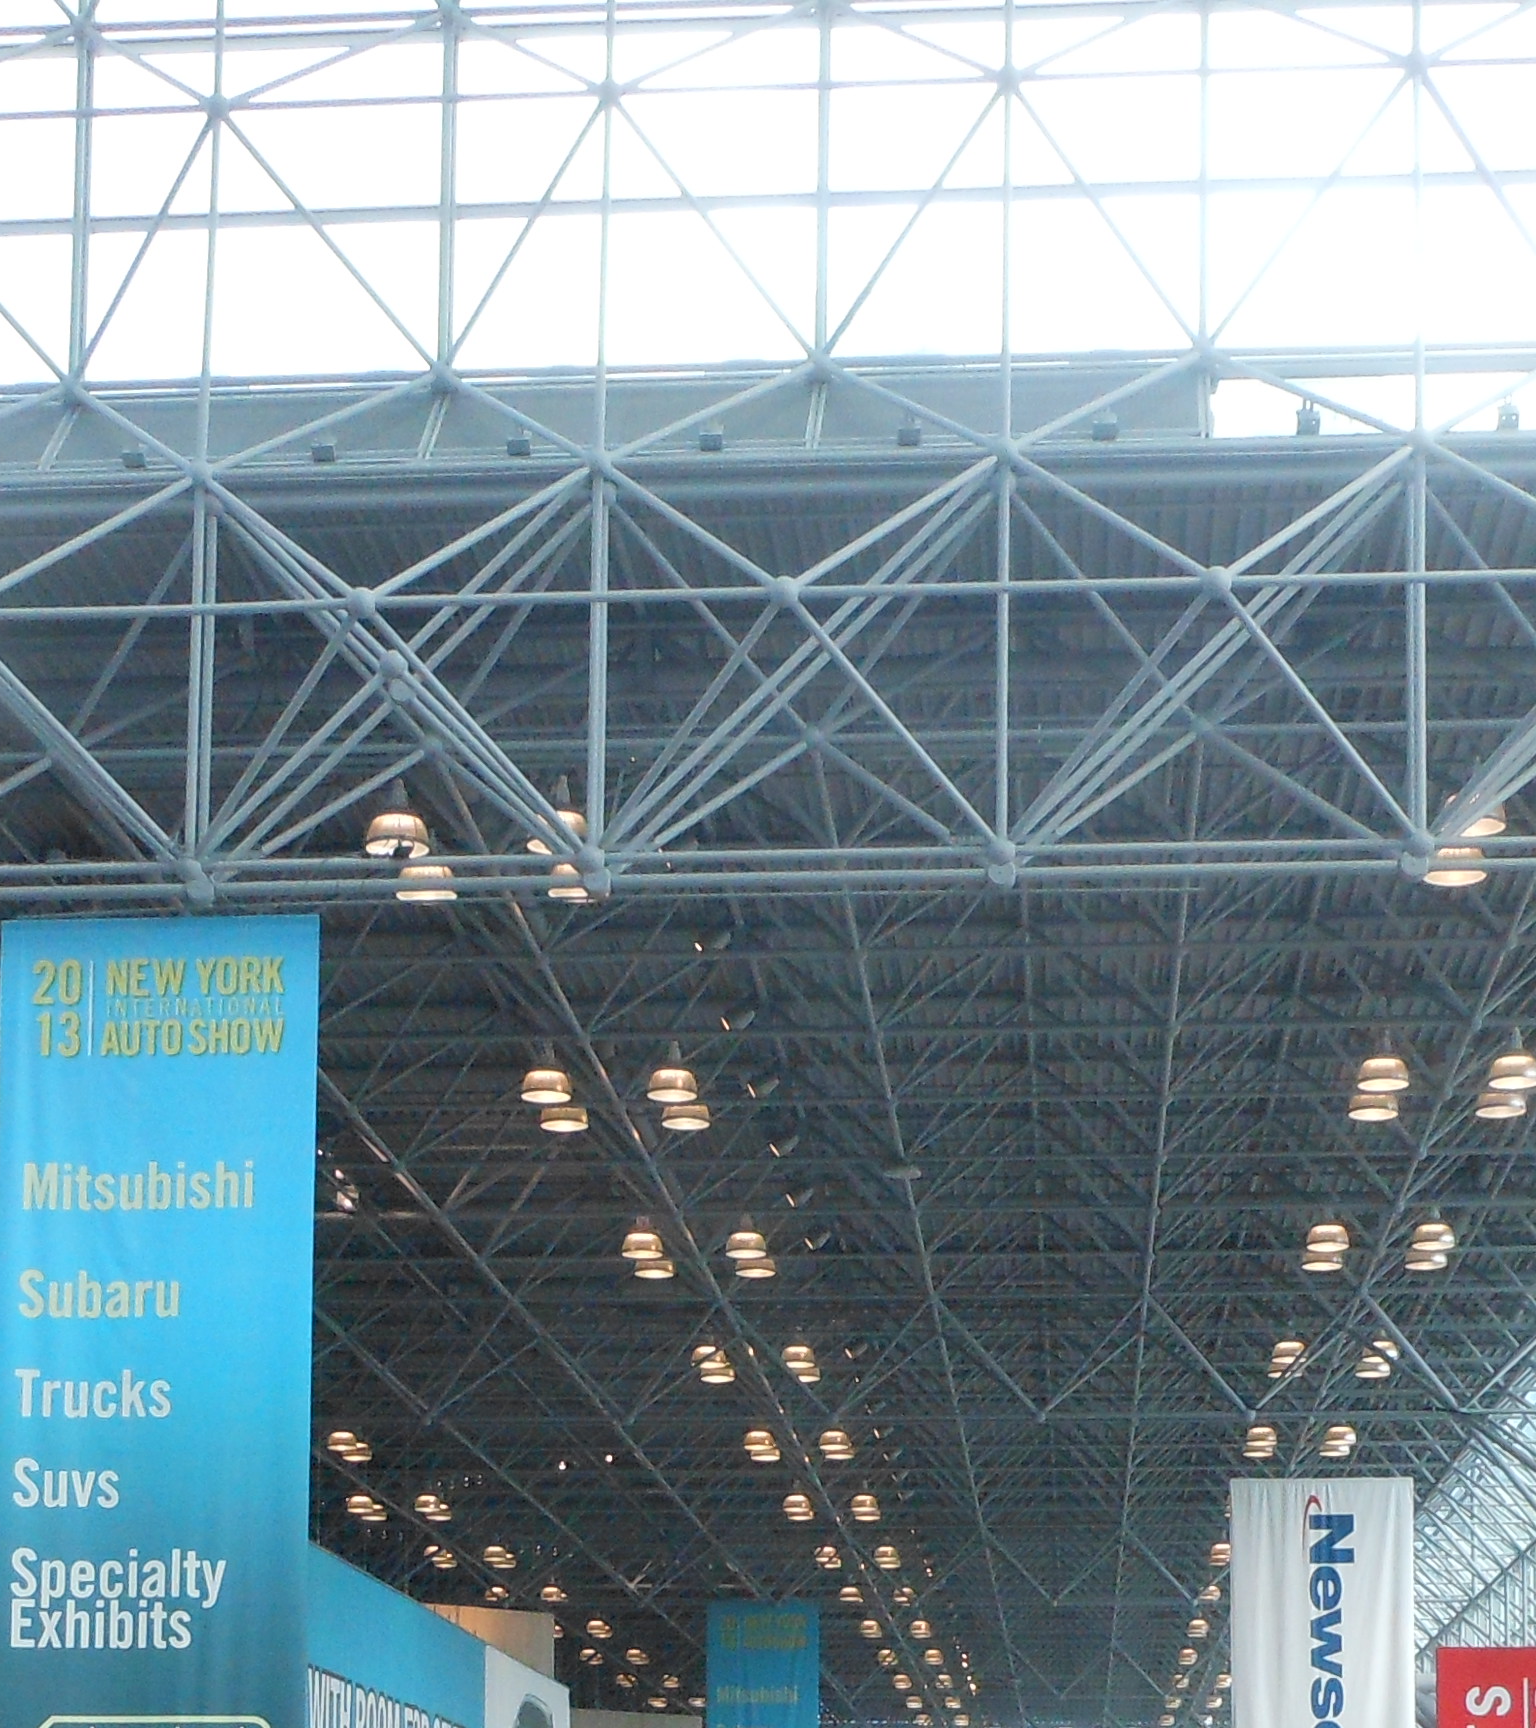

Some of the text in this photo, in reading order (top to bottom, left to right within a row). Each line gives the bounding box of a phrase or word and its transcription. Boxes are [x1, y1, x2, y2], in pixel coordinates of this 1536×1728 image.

[32, 958, 82, 1005] 20
[106, 956, 285, 998] NEW YORK
[106, 998, 285, 1017] INTERNATIONAL
[37, 1011, 81, 1057] 13
[100, 1018, 284, 1056] AUTO SHOW
[21, 1160, 254, 1210] Mitsubishi
[18, 1269, 180, 1318] Subaru
[15, 1368, 172, 1419] Trucks
[11, 1457, 119, 1508] Suvs
[9, 1548, 227, 1610] Specialty
[9, 1600, 193, 1650] Exhibits
